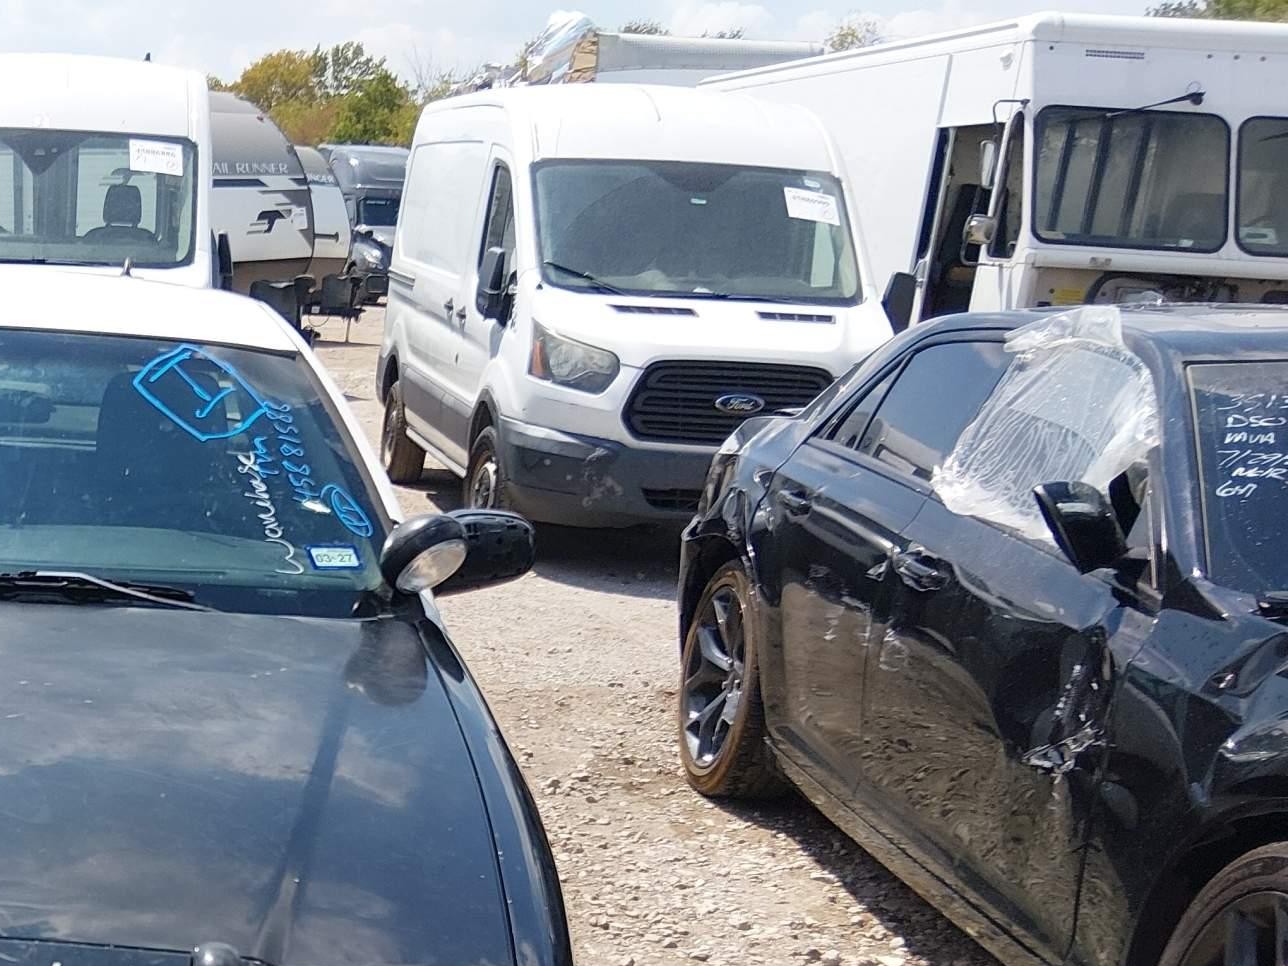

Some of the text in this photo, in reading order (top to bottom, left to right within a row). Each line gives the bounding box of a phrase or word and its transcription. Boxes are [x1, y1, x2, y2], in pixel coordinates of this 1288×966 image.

[236, 162, 289, 174] RUNNER
[727, 398, 755, 410] Ford
[315, 553, 353, 563] 03-27
